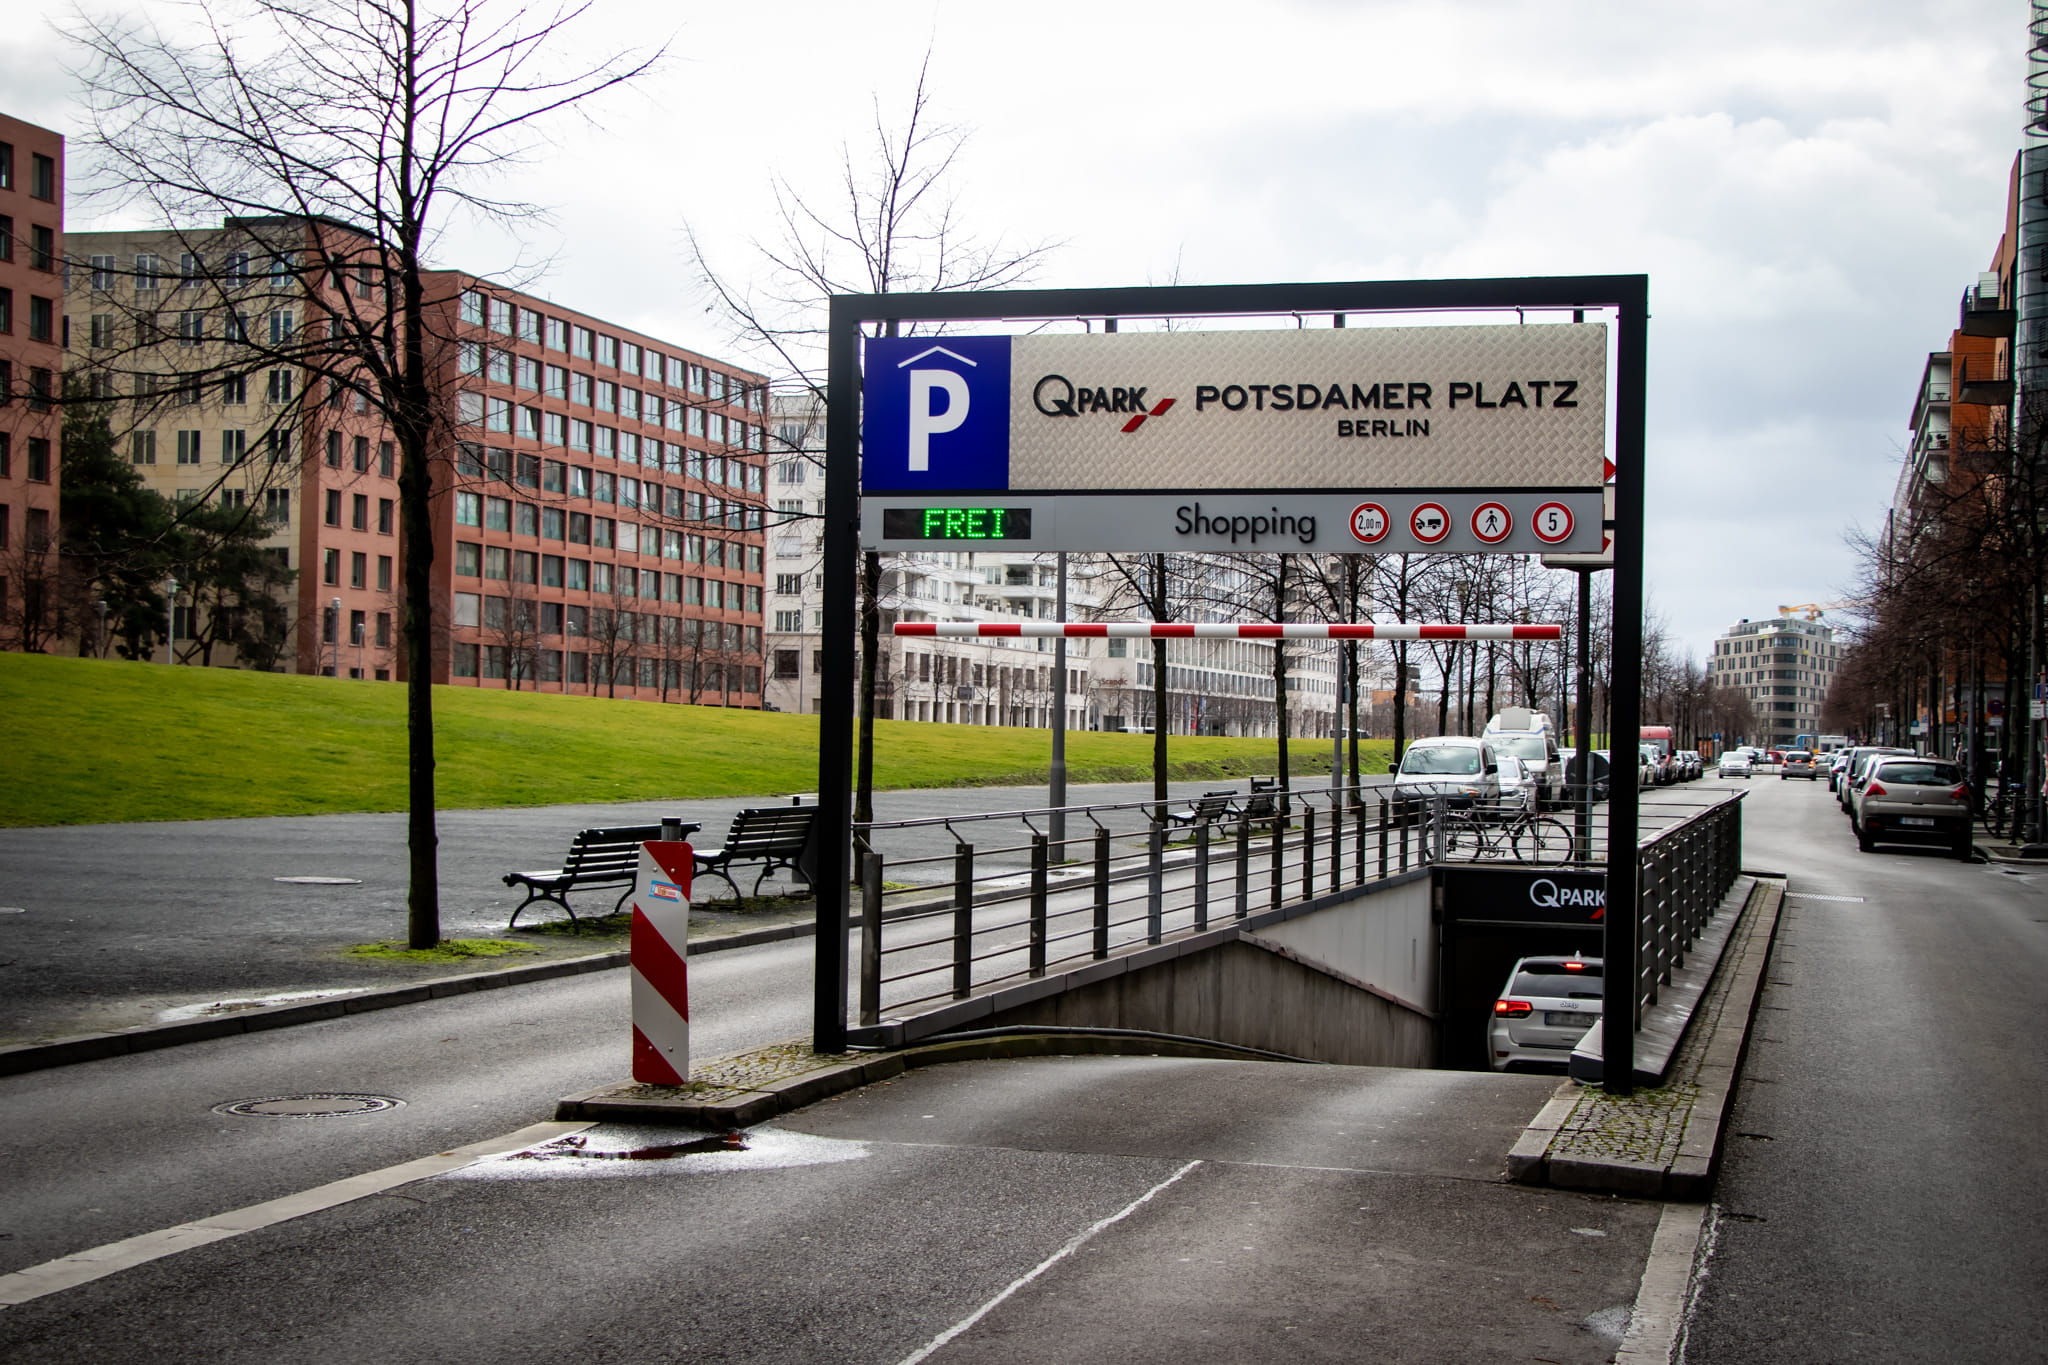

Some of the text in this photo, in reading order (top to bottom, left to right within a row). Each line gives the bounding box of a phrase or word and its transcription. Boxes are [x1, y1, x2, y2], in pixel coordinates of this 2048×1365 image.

[1195, 380, 1579, 411] POTSDAMER PLATZ
[908, 369, 970, 471] P
[1337, 418, 1431, 438] BERLIN
[923, 508, 1005, 538] FREI
[1174, 502, 1317, 544] Shopping
[1548, 512, 1558, 531] 5
